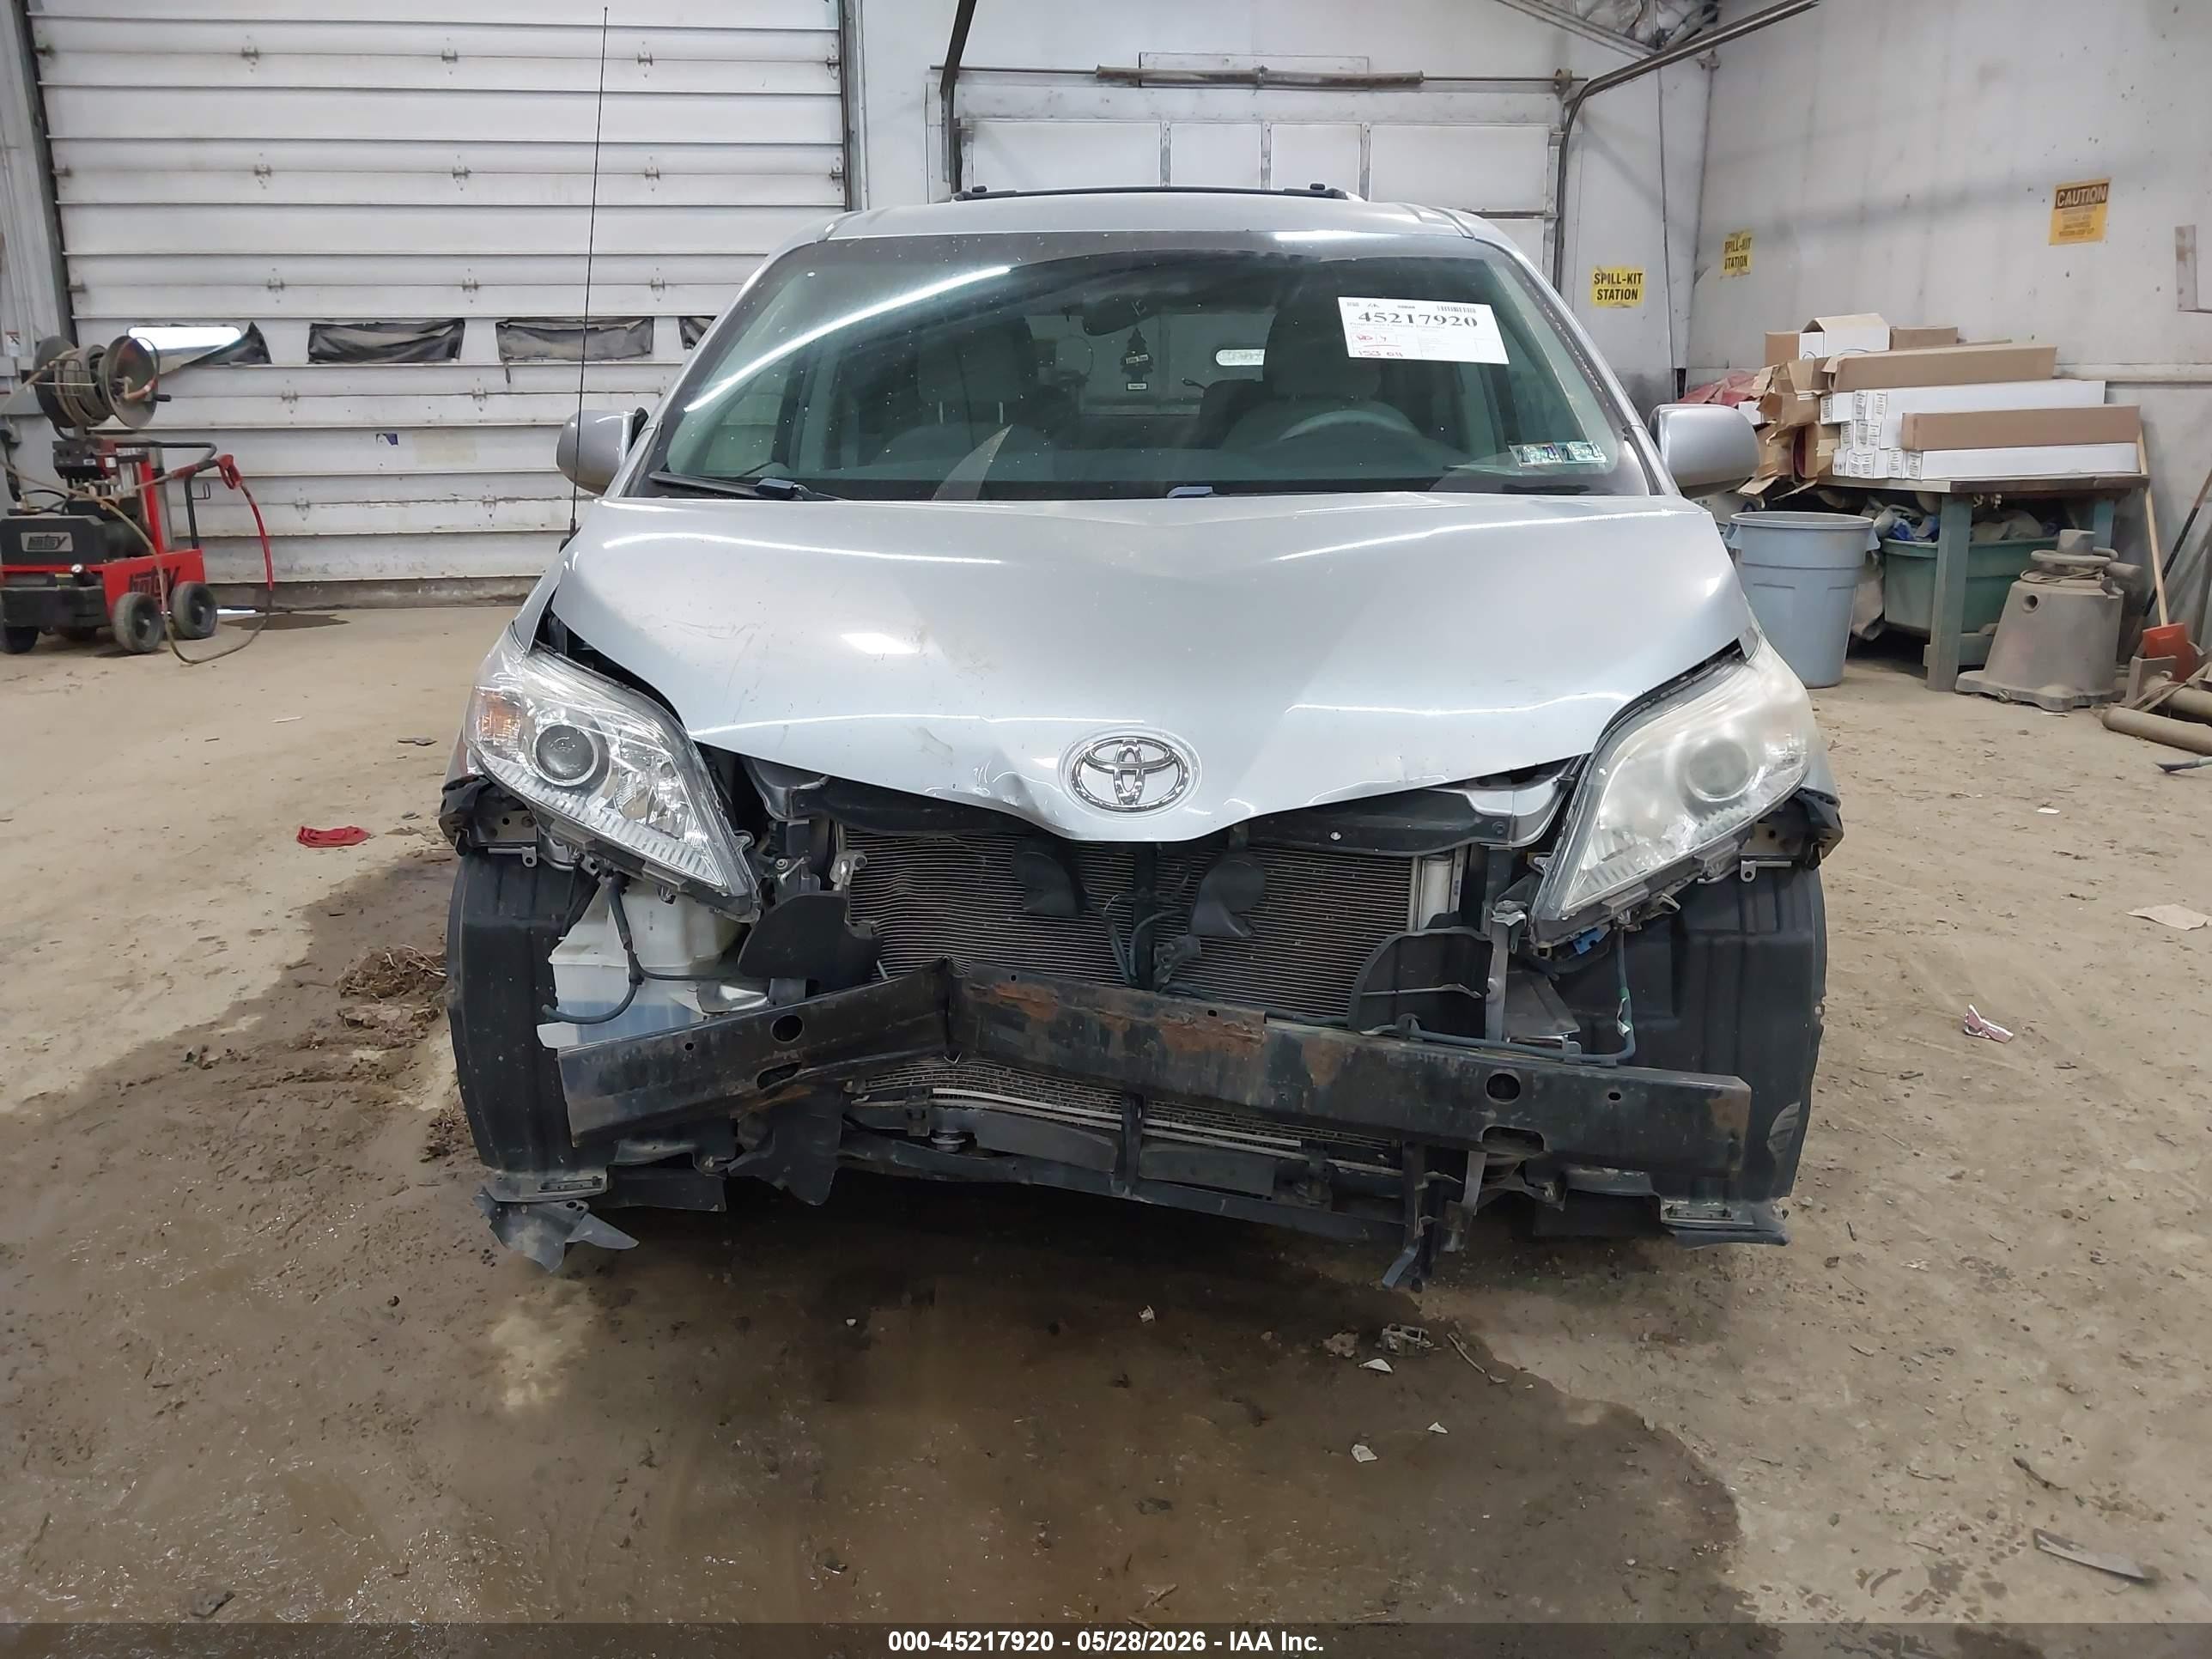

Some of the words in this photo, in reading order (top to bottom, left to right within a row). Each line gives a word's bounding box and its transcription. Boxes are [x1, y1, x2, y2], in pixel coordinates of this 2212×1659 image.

[2057, 185, 2107, 207] CAUTION
[1724, 237, 1753, 253] SPILL-KIT
[1724, 254, 1748, 270] STATION
[1594, 272, 1644, 285] SPILL-KIT
[1596, 288, 1638, 301] STATION
[1358, 312, 1479, 328] 45217920
